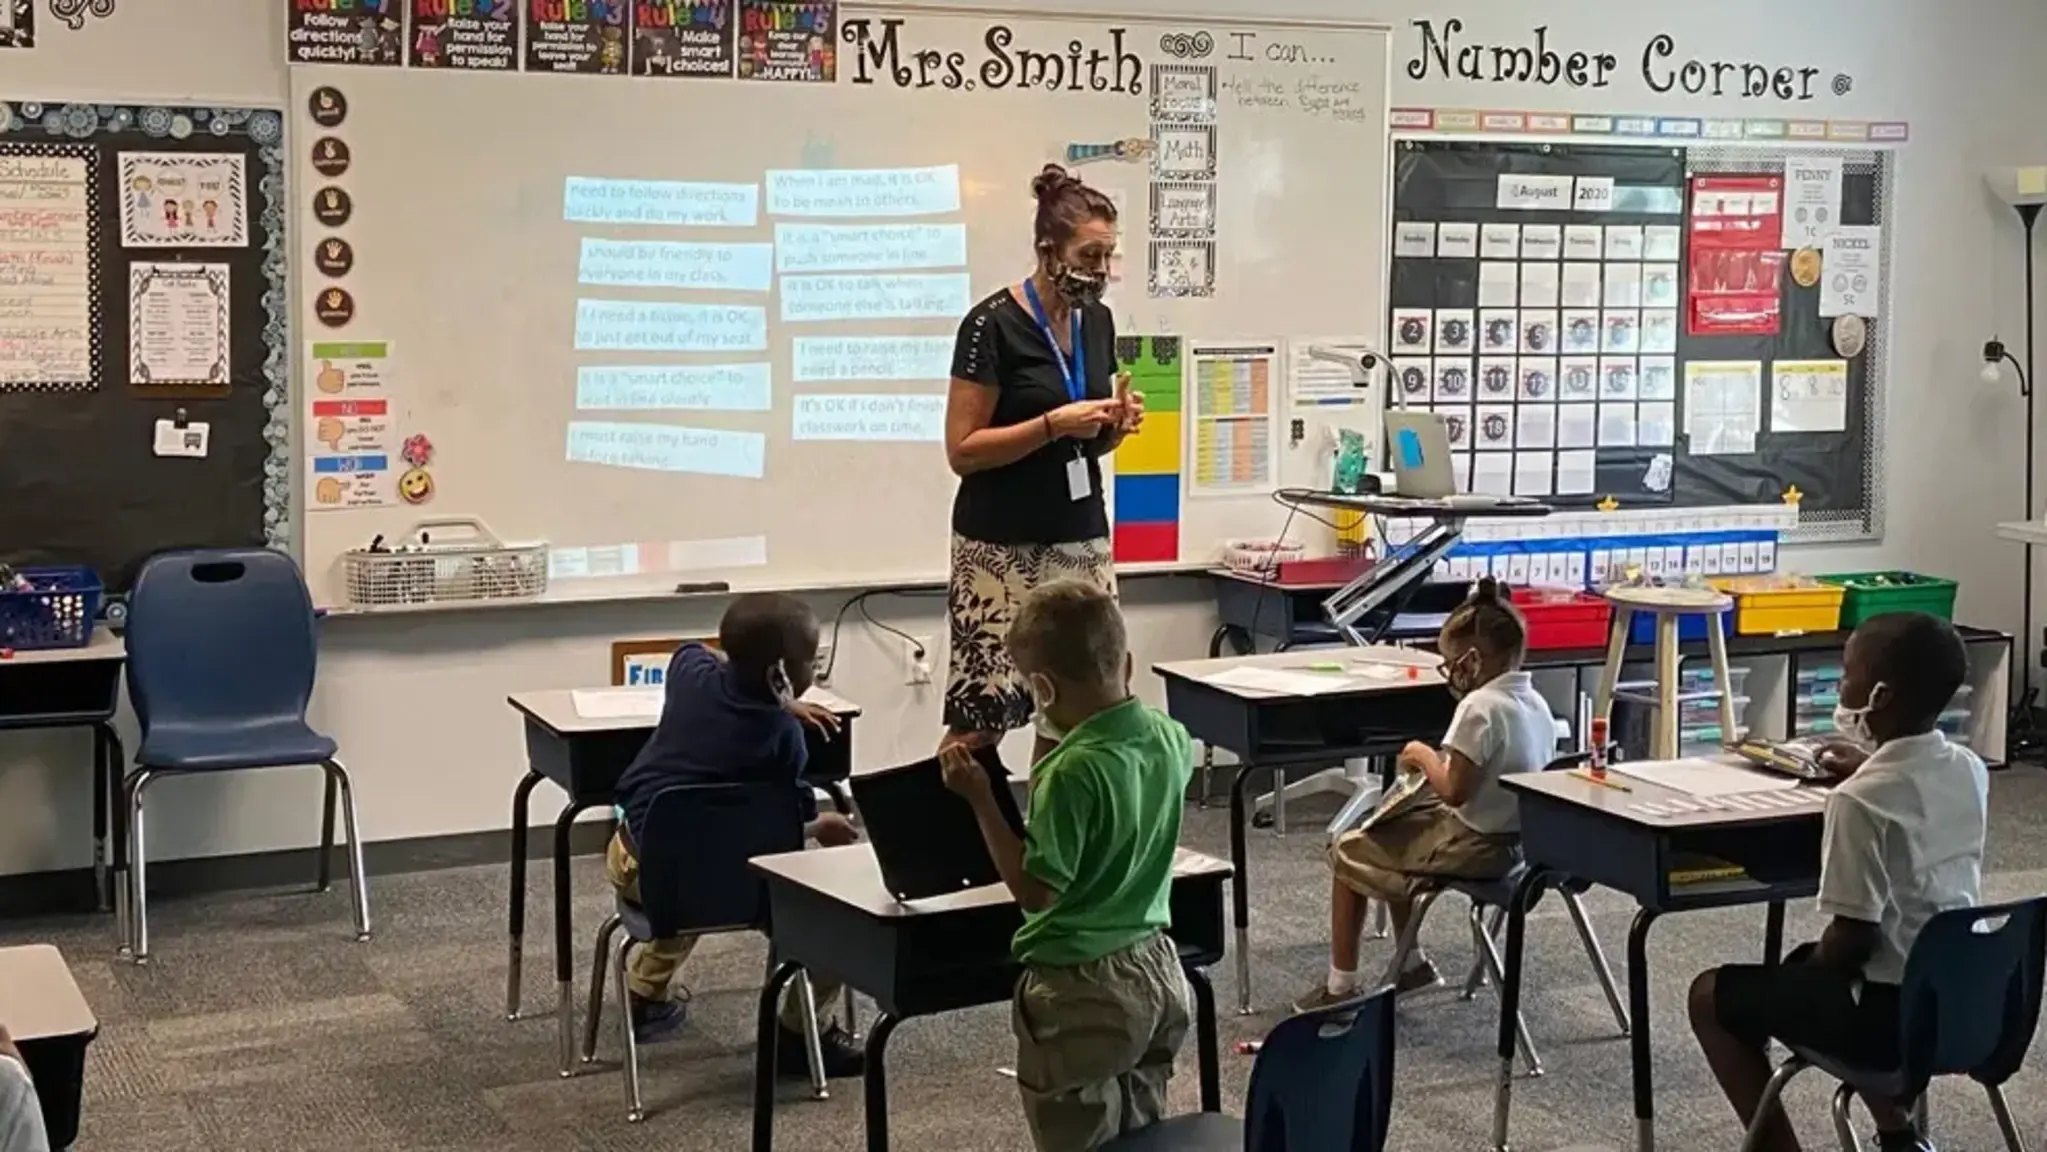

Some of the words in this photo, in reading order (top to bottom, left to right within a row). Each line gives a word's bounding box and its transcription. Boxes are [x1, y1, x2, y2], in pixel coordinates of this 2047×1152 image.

[532, 0, 587, 22] Rule
[637, 4, 692, 27] Rule
[303, 13, 349, 28] Follow
[447, 17, 481, 31] Raise
[482, 21, 512, 32] your
[540, 21, 566, 32] Raise
[745, 8, 797, 33] Rule
[290, 28, 362, 44] directions
[453, 30, 485, 42] hand
[487, 31, 506, 43] for
[544, 31, 569, 41] hand
[681, 30, 721, 45] Make
[298, 45, 356, 62] quickly!
[446, 43, 513, 56] permission
[532, 41, 585, 52] permission
[681, 45, 722, 59] smart
[1227, 32, 1257, 61] I
[451, 55, 465, 66] to
[673, 58, 731, 73] choices!
[979, 26, 1143, 96] Smith
[1407, 19, 1617, 88] Number
[1642, 34, 1820, 101] Corner
[1162, 139, 1204, 161] Math
[1794, 168, 1833, 181] PENNY
[775, 176, 815, 188] When
[571, 185, 607, 199] need
[610, 186, 627, 199] to
[629, 186, 672, 201] follow
[676, 186, 746, 202] directions
[1520, 184, 1558, 200] August
[1578, 187, 1609, 201] 2020
[793, 197, 810, 208] be
[614, 206, 642, 219] and
[1170, 211, 1200, 228] Arts
[927, 228, 942, 239] to
[1832, 238, 1871, 250] NICKEL
[659, 246, 713, 263] friendly
[717, 249, 732, 262] to
[816, 278, 835, 291] OK
[838, 279, 853, 291] to
[857, 278, 881, 291] talk
[598, 309, 635, 322] need
[1409, 323, 1418, 337] 2
[1451, 323, 1460, 338] 3
[1534, 328, 1542, 343] 5
[650, 331, 675, 344] out
[678, 330, 695, 344] of
[697, 334, 719, 347] my
[808, 342, 843, 355] need
[847, 342, 861, 355] to
[901, 343, 919, 356] my
[728, 371, 744, 384] to
[1408, 374, 1418, 388] 9
[1446, 375, 1462, 389] 10
[1490, 373, 1505, 388] 11
[1530, 378, 1545, 392] 12
[825, 398, 845, 412] OK
[868, 398, 904, 413] don't
[799, 419, 866, 433] classwork
[870, 422, 888, 433] on
[1488, 420, 1502, 437] 18
[657, 434, 680, 447] my
[682, 433, 719, 447] hand
